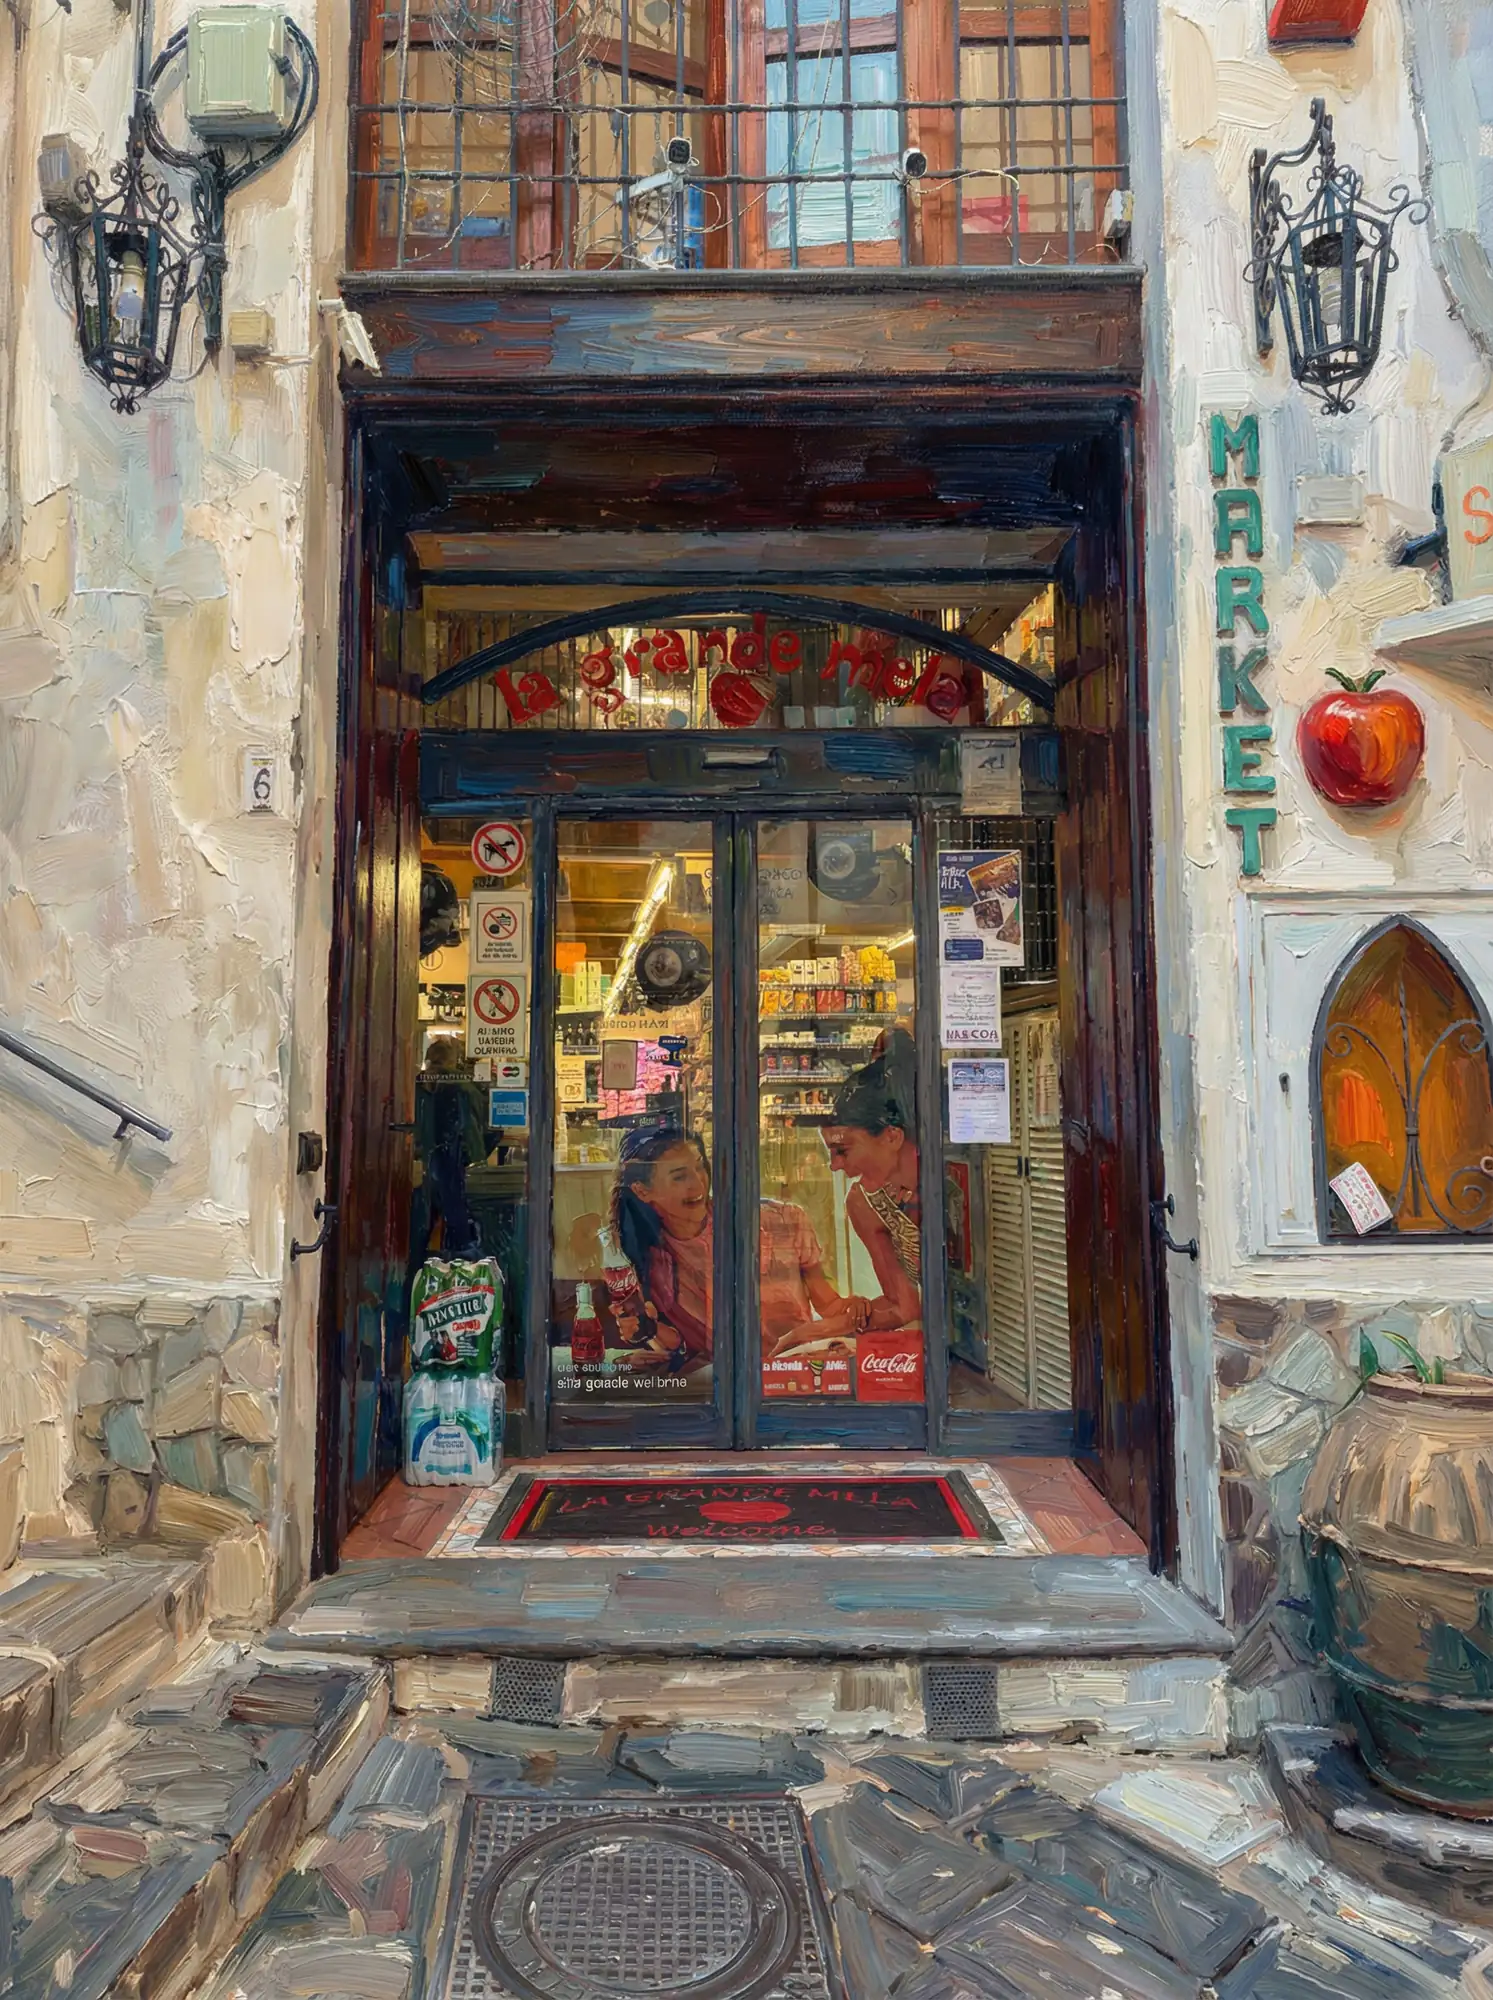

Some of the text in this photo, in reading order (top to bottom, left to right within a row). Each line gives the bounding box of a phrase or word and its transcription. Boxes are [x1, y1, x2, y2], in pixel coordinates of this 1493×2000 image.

[494, 611, 966, 724] la grande mela
[1210, 413, 1277, 877] MARKET
[253, 767, 271, 800] 6
[861, 1353, 919, 1374] Coca-Cola
